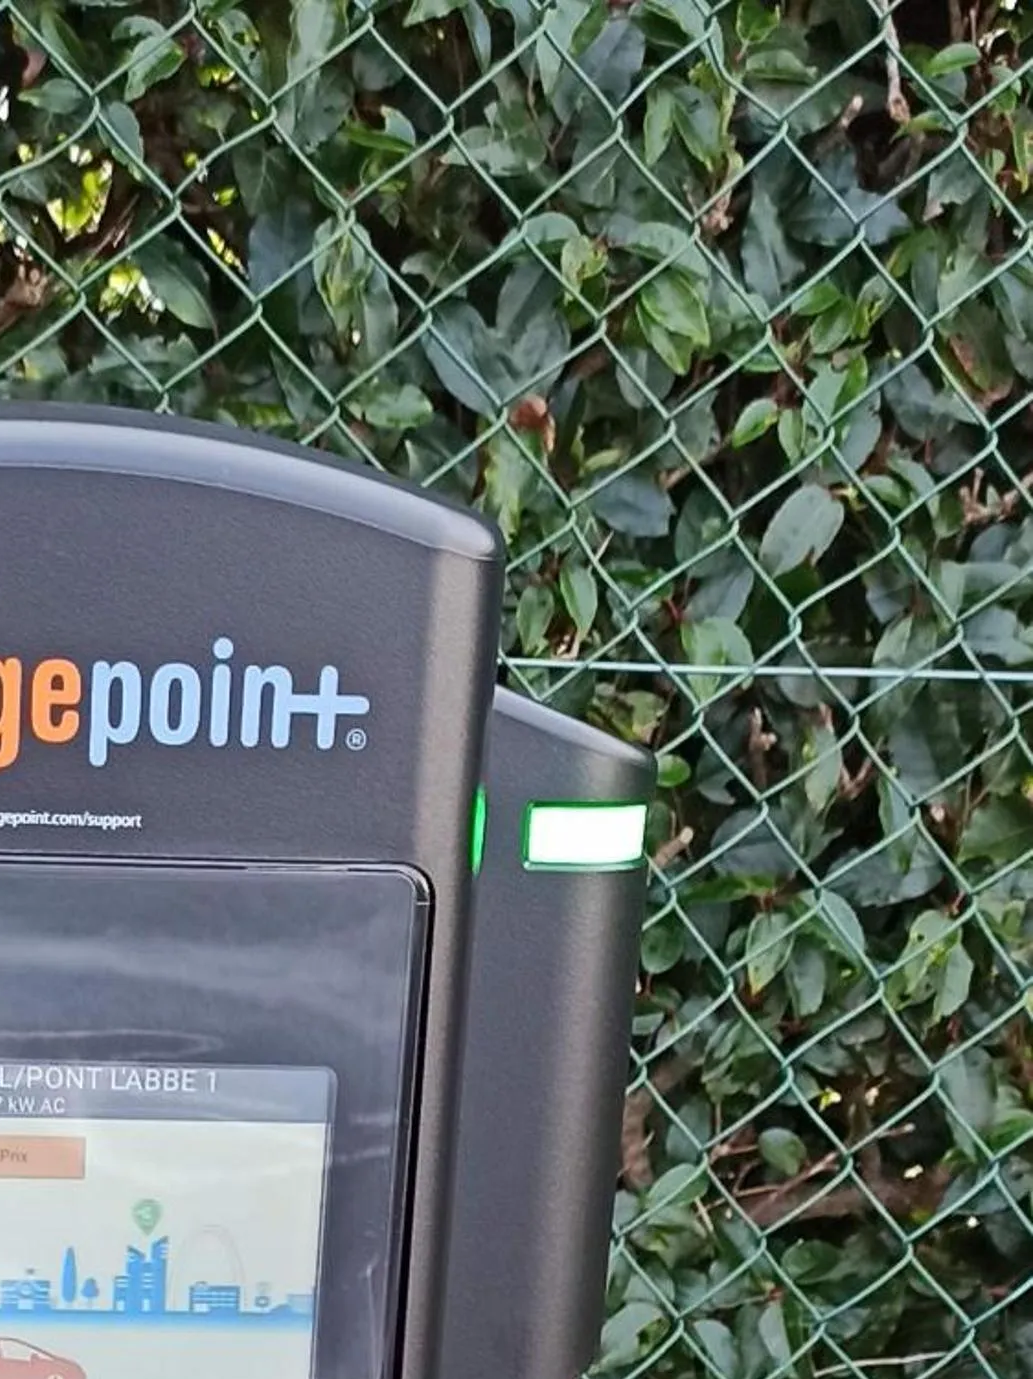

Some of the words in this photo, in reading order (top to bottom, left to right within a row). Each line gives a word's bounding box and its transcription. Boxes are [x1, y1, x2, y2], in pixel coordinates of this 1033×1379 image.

[110, 1068, 197, 1092] L'ABBE
[207, 1071, 218, 1093] 1
[7, 1096, 36, 1114] kW
[39, 1097, 67, 1114] AC
